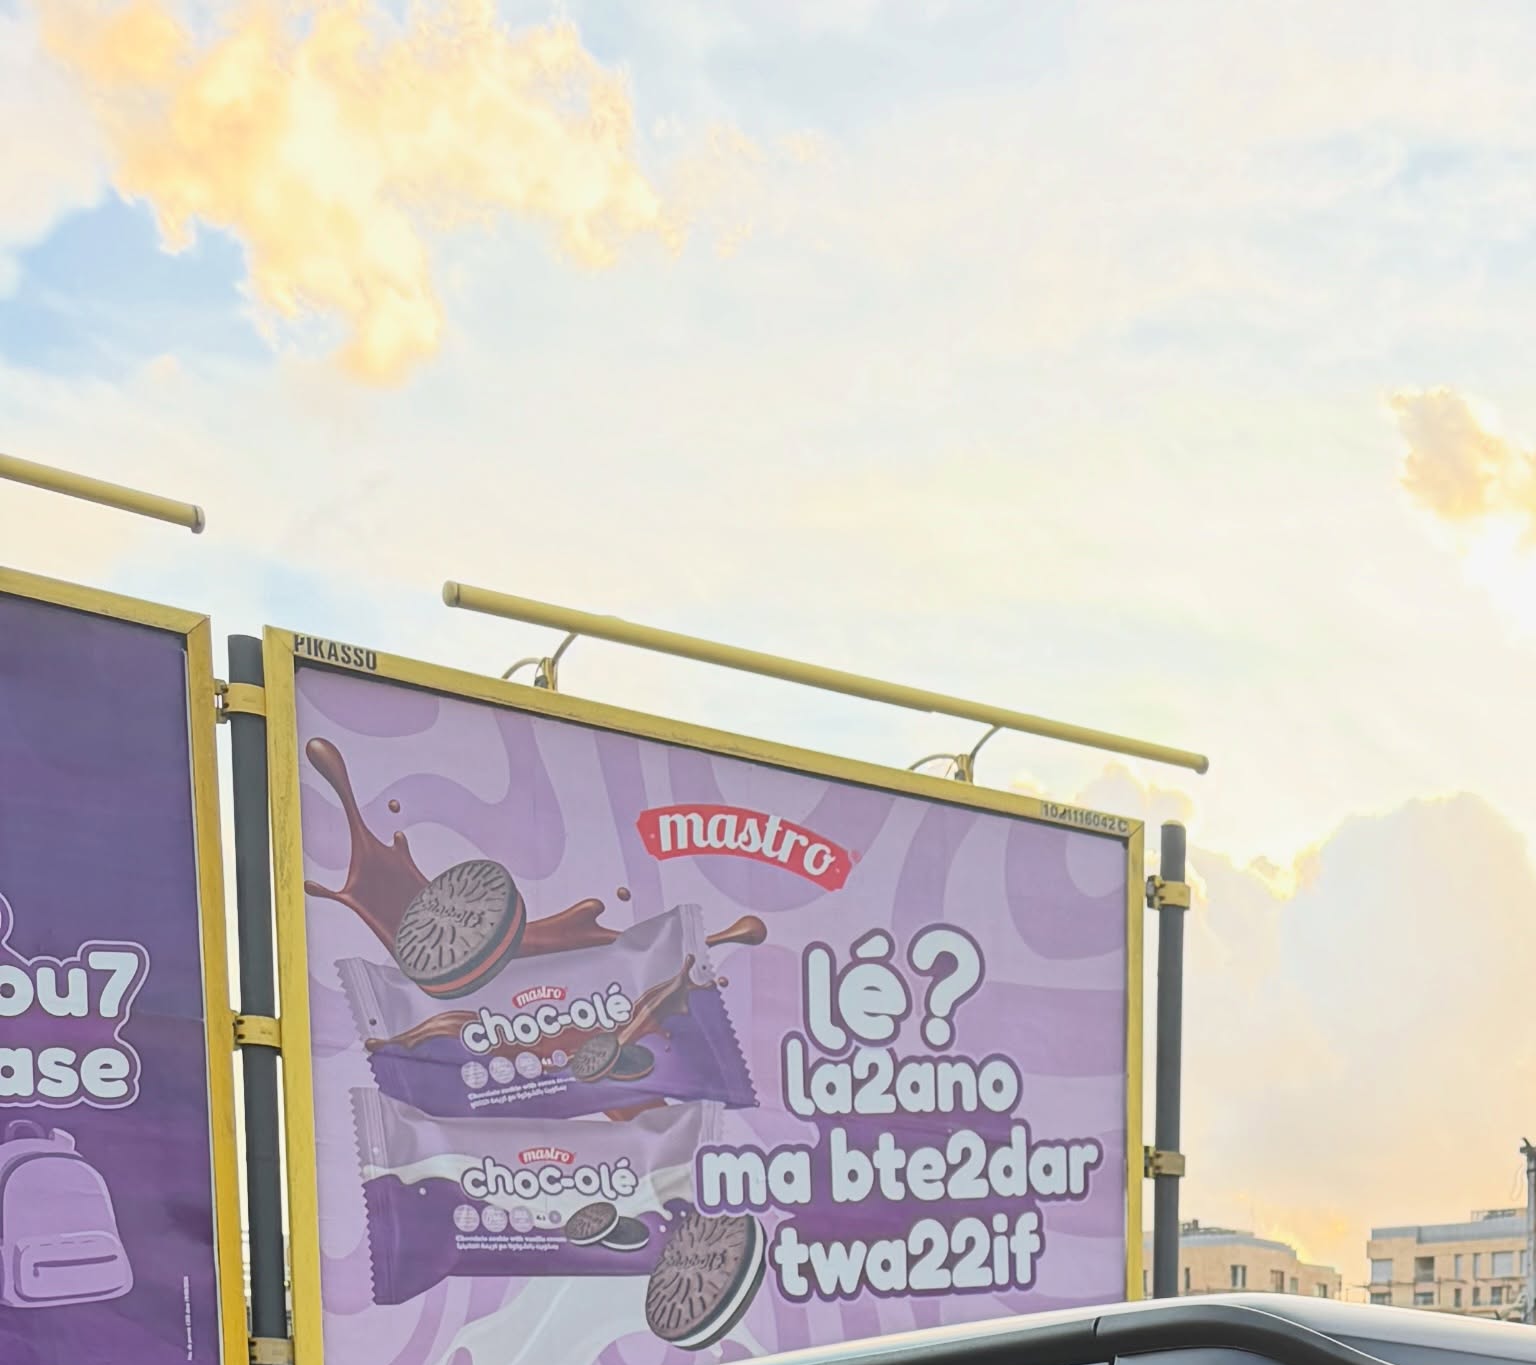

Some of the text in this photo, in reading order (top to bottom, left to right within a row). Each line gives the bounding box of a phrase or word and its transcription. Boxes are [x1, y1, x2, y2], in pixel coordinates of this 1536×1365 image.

[294, 634, 377, 671] PIKASSO
[660, 812, 836, 877] mastro
[0, 951, 139, 1018] ou7
[463, 983, 632, 1052] choc-olé
[517, 986, 563, 1007] mastro
[806, 929, 981, 1051] lé?
[0, 1047, 130, 1098] ase
[786, 1038, 1019, 1117] la2ano
[463, 1157, 638, 1199] choc-olé
[522, 1148, 571, 1163] mastro
[701, 1121, 1099, 1206] ma bte2dar
[775, 1211, 1042, 1295] twa22if
